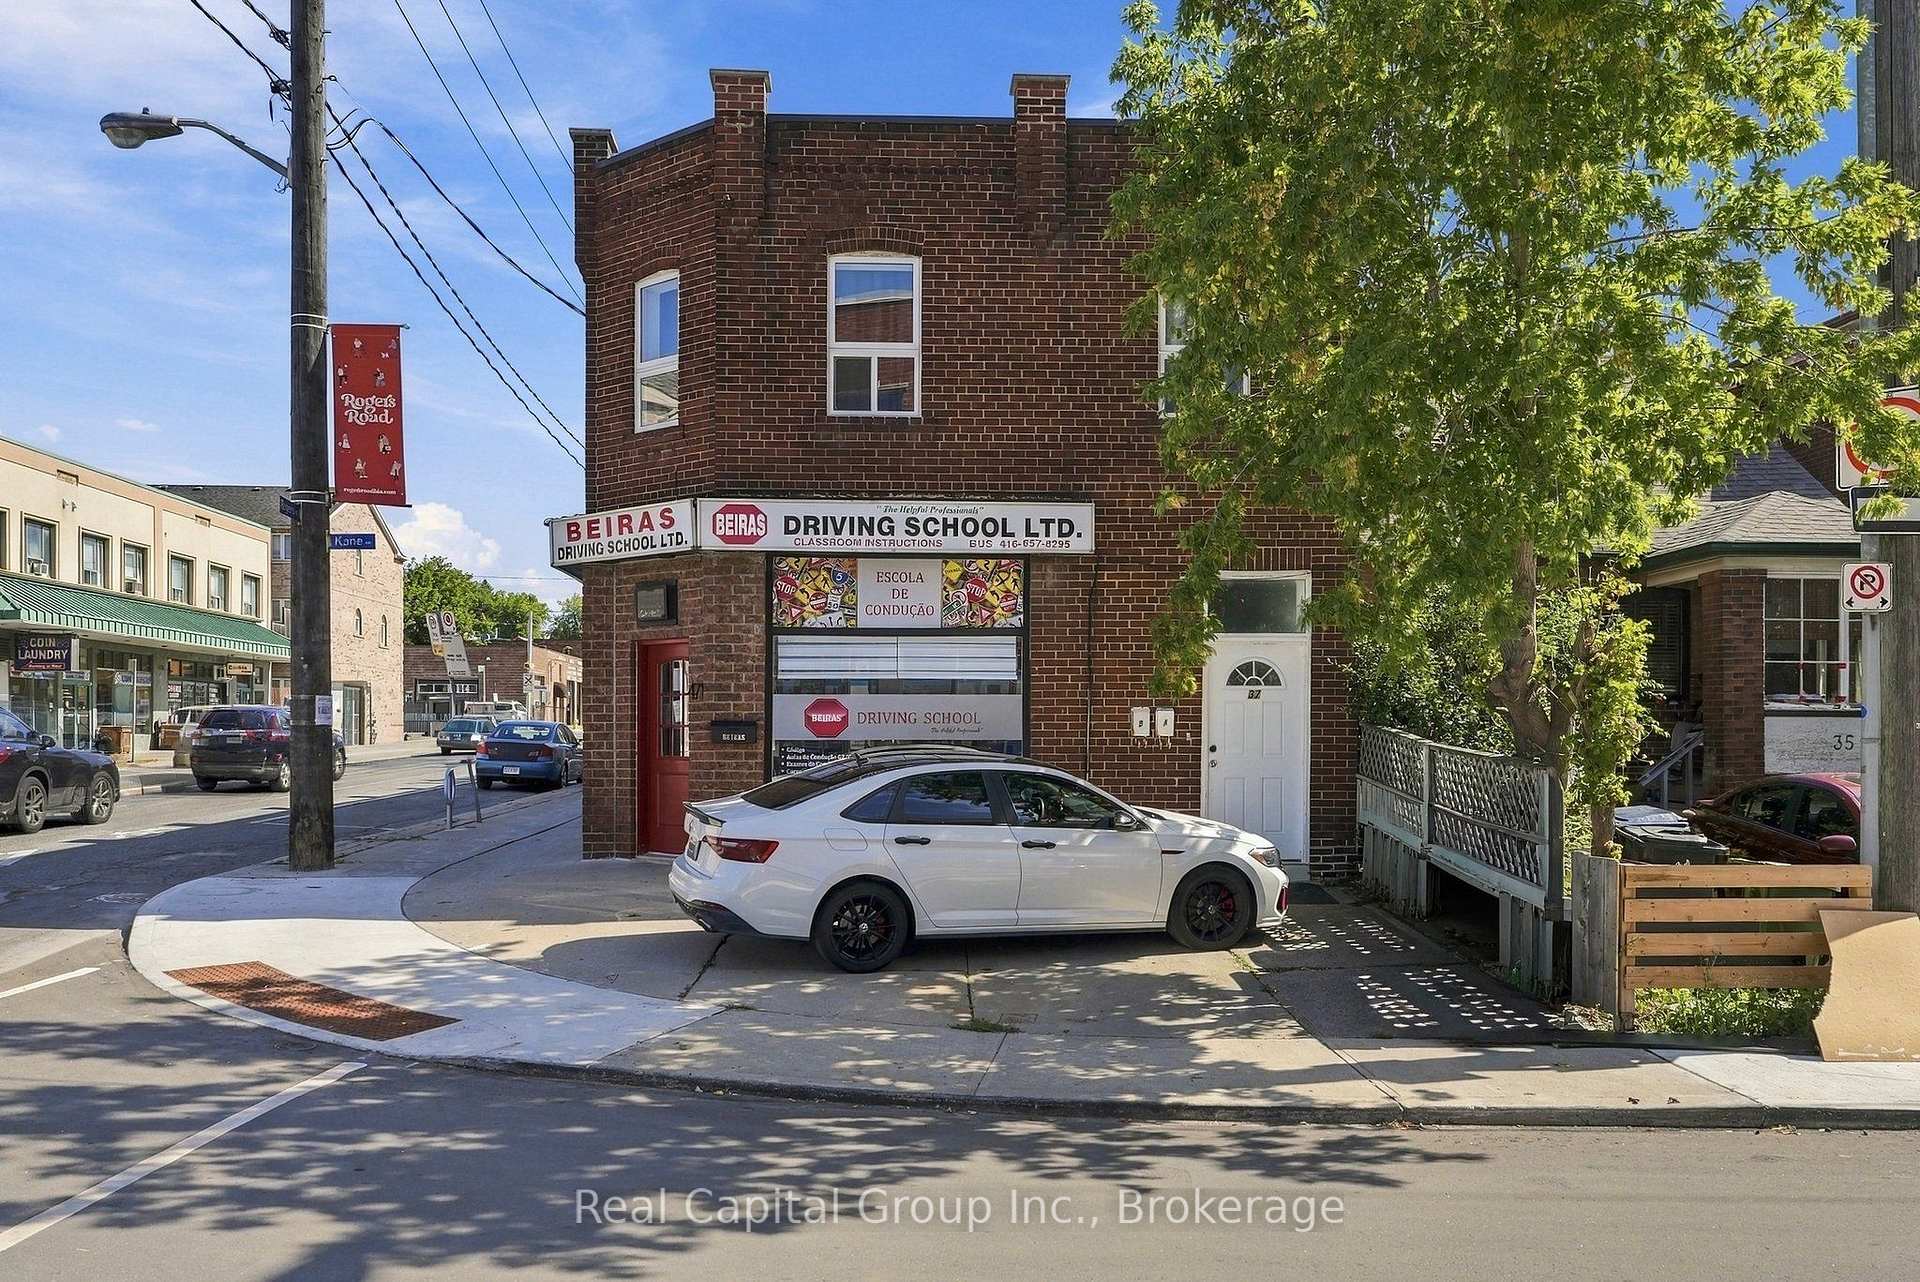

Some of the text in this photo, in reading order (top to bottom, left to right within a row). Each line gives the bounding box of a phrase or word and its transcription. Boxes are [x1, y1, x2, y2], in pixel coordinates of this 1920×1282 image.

[341, 394, 396, 414] Rogers
[344, 409, 394, 425] Road
[899, 505, 928, 514] Helpful
[566, 507, 676, 543] BEIRAS
[715, 513, 767, 537] BEIRAS
[783, 515, 1083, 538] DRIVING SCHOOL LTD.
[335, 535, 363, 546] Kane
[557, 531, 688, 561] DRIVING SCHOOL LTD.
[793, 537, 1071, 549] CLASSROOM INSTRUCTIONS BUS 416-657-8295
[876, 571, 924, 583] ESCOLA
[776, 581, 797, 595] STOP
[892, 588, 909, 600] DE
[966, 582, 986, 597] STOP
[865, 603, 935, 618] CONDUÇÃO
[30, 638, 56, 647] COIN
[18, 649, 69, 660] LAUNDRY
[811, 714, 842, 722] BEIRAS
[857, 711, 982, 725] DRIVING SCHOOL
[1832, 734, 1855, 751] 35
